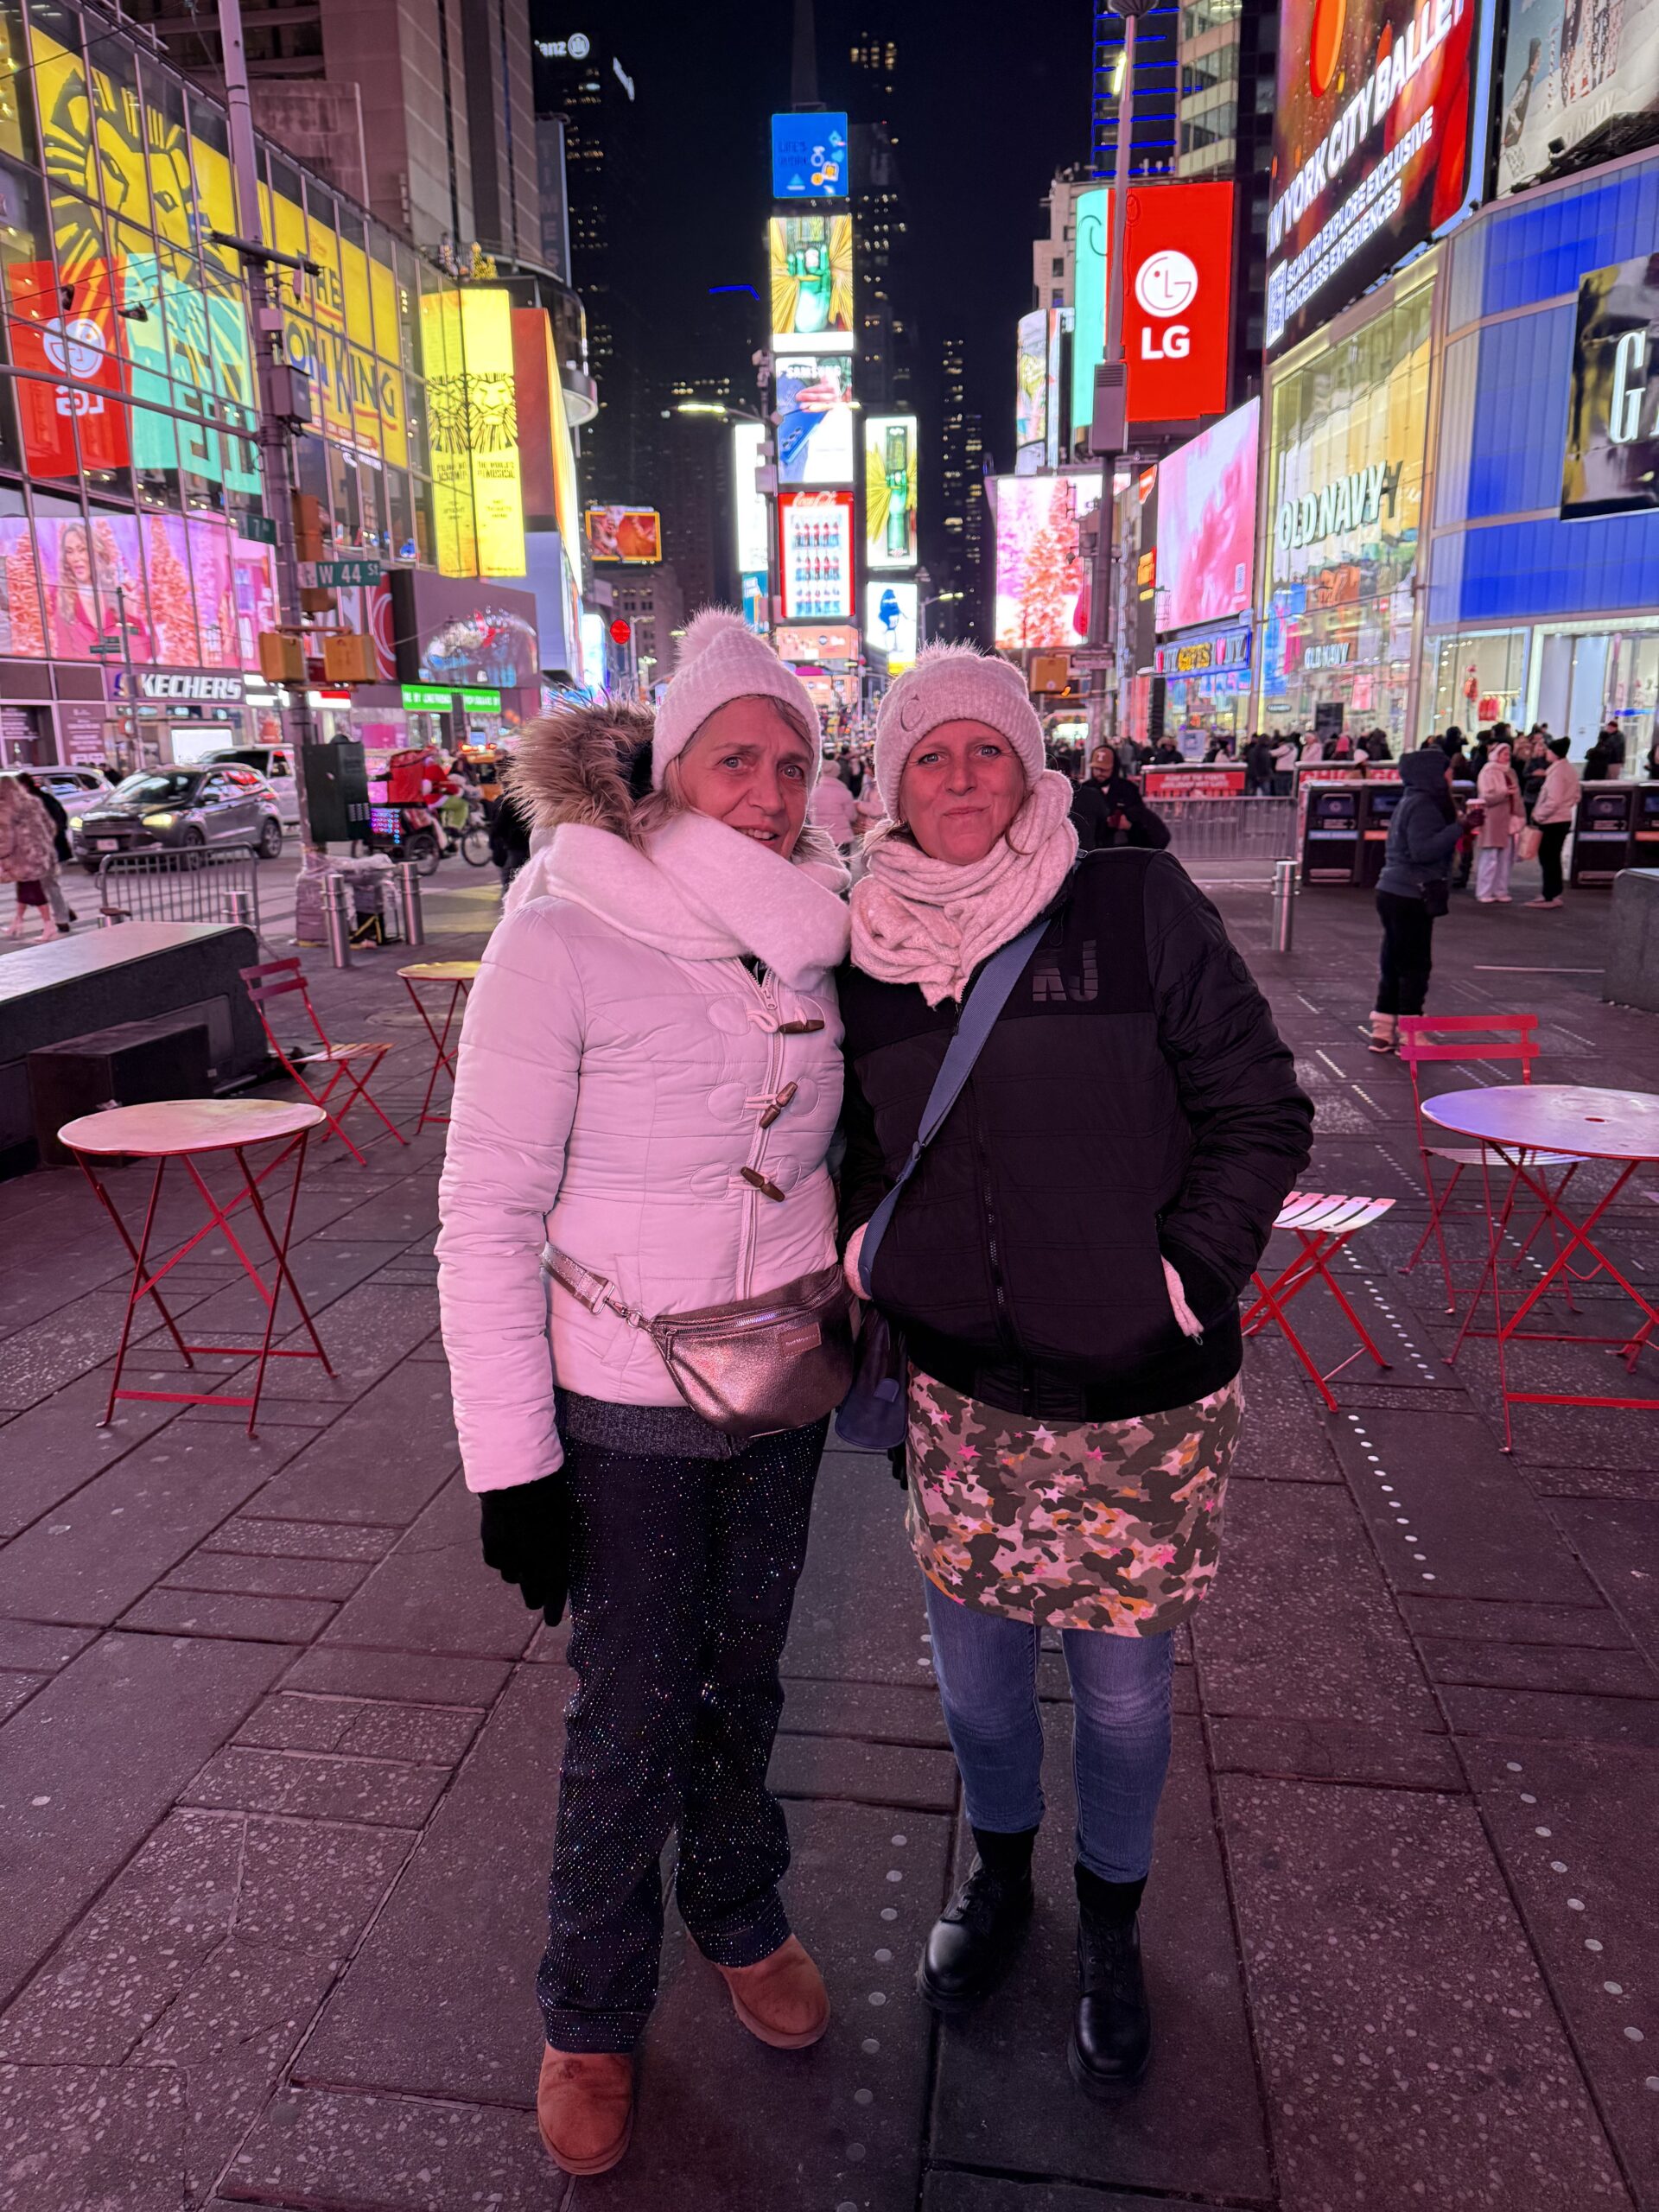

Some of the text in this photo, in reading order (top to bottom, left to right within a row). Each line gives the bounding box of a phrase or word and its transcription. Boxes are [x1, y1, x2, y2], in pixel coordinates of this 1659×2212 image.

[1328, 74, 1375, 178] CITY
[1366, 105, 1433, 203] EXCLUSIVE
[331, 320, 396, 419] KING
[1141, 325, 1191, 360] LG
[1279, 460, 1387, 550] OLD NAVY
[319, 563, 379, 584] W 44 St
